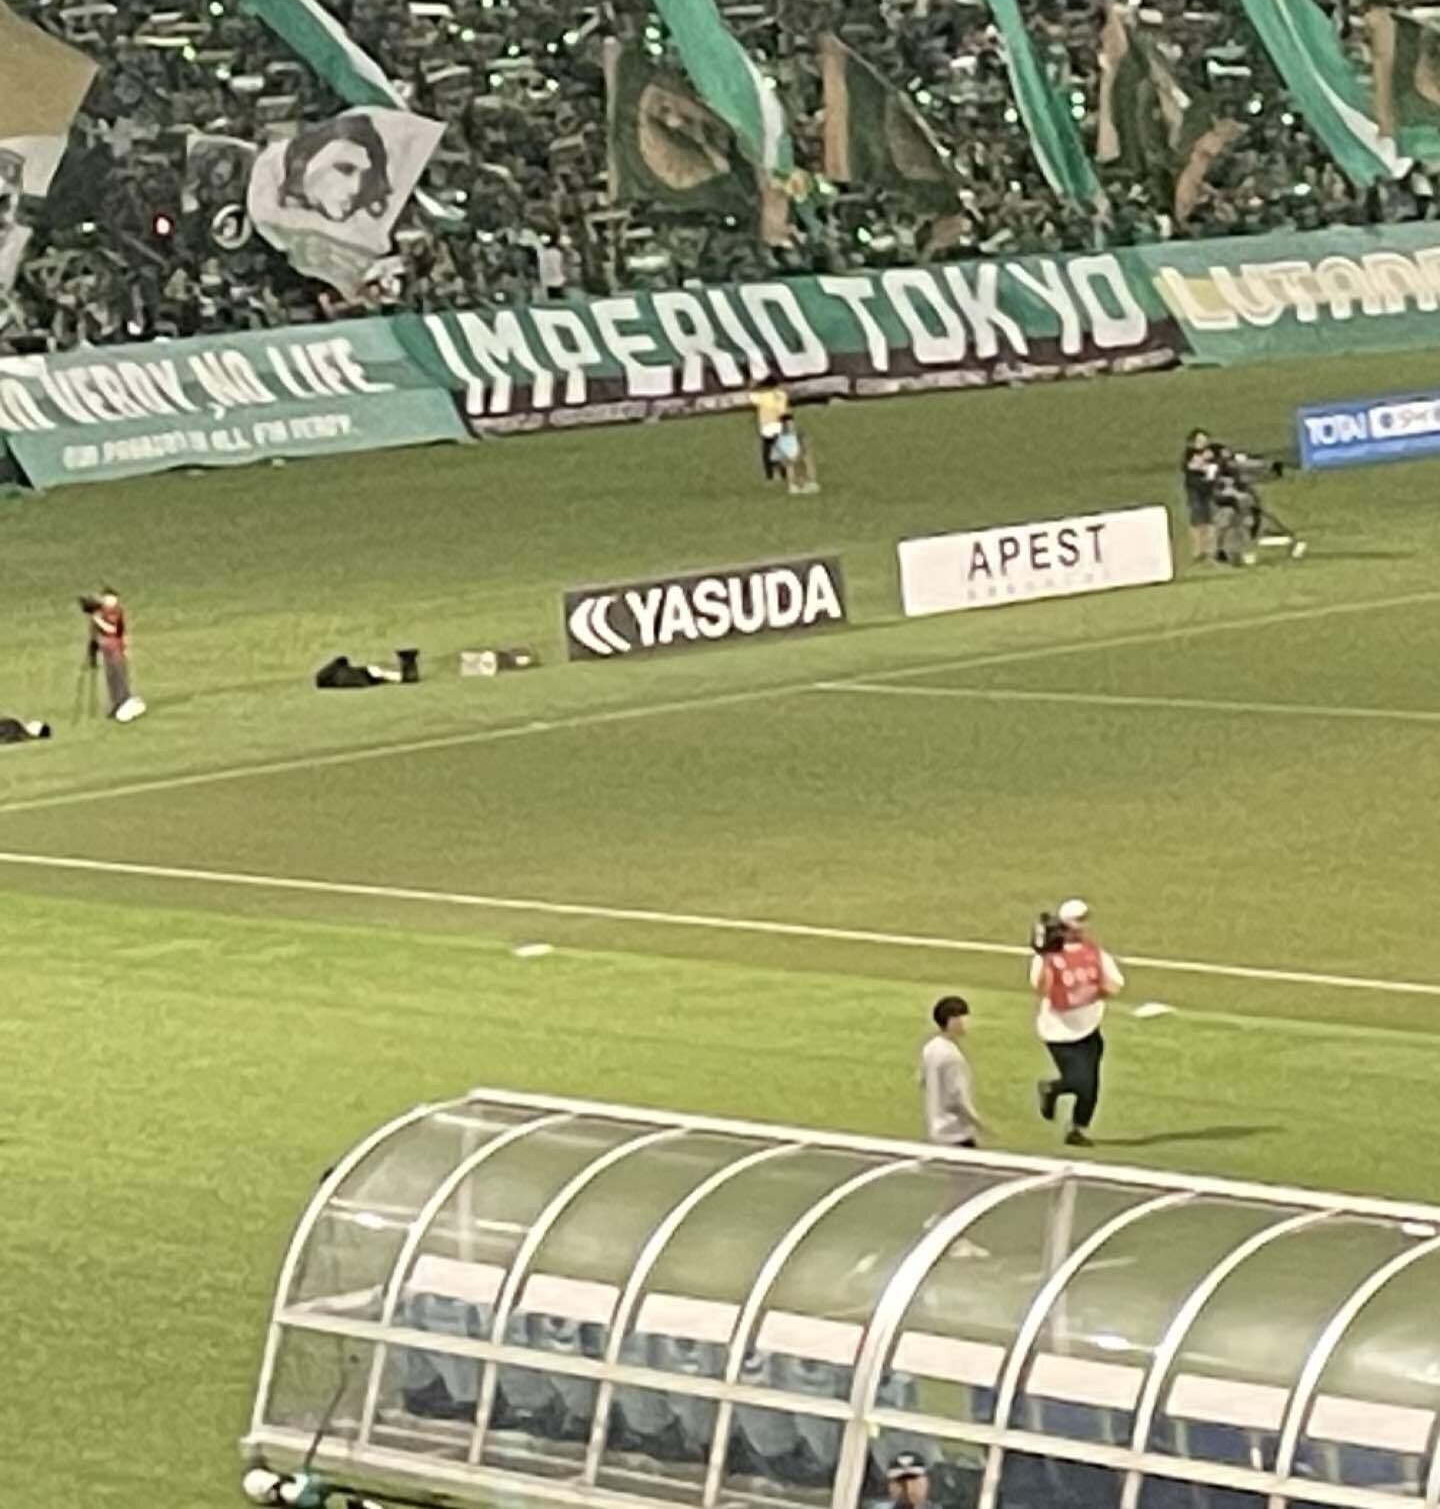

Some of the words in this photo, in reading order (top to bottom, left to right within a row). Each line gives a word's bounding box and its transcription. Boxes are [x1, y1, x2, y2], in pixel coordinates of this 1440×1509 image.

[269, 336, 398, 401] LIFE
[425, 278, 832, 416] IMPERIO
[817, 255, 1150, 372] TOKYO
[966, 524, 1107, 581] APEST
[625, 563, 841, 646] YASUDA
